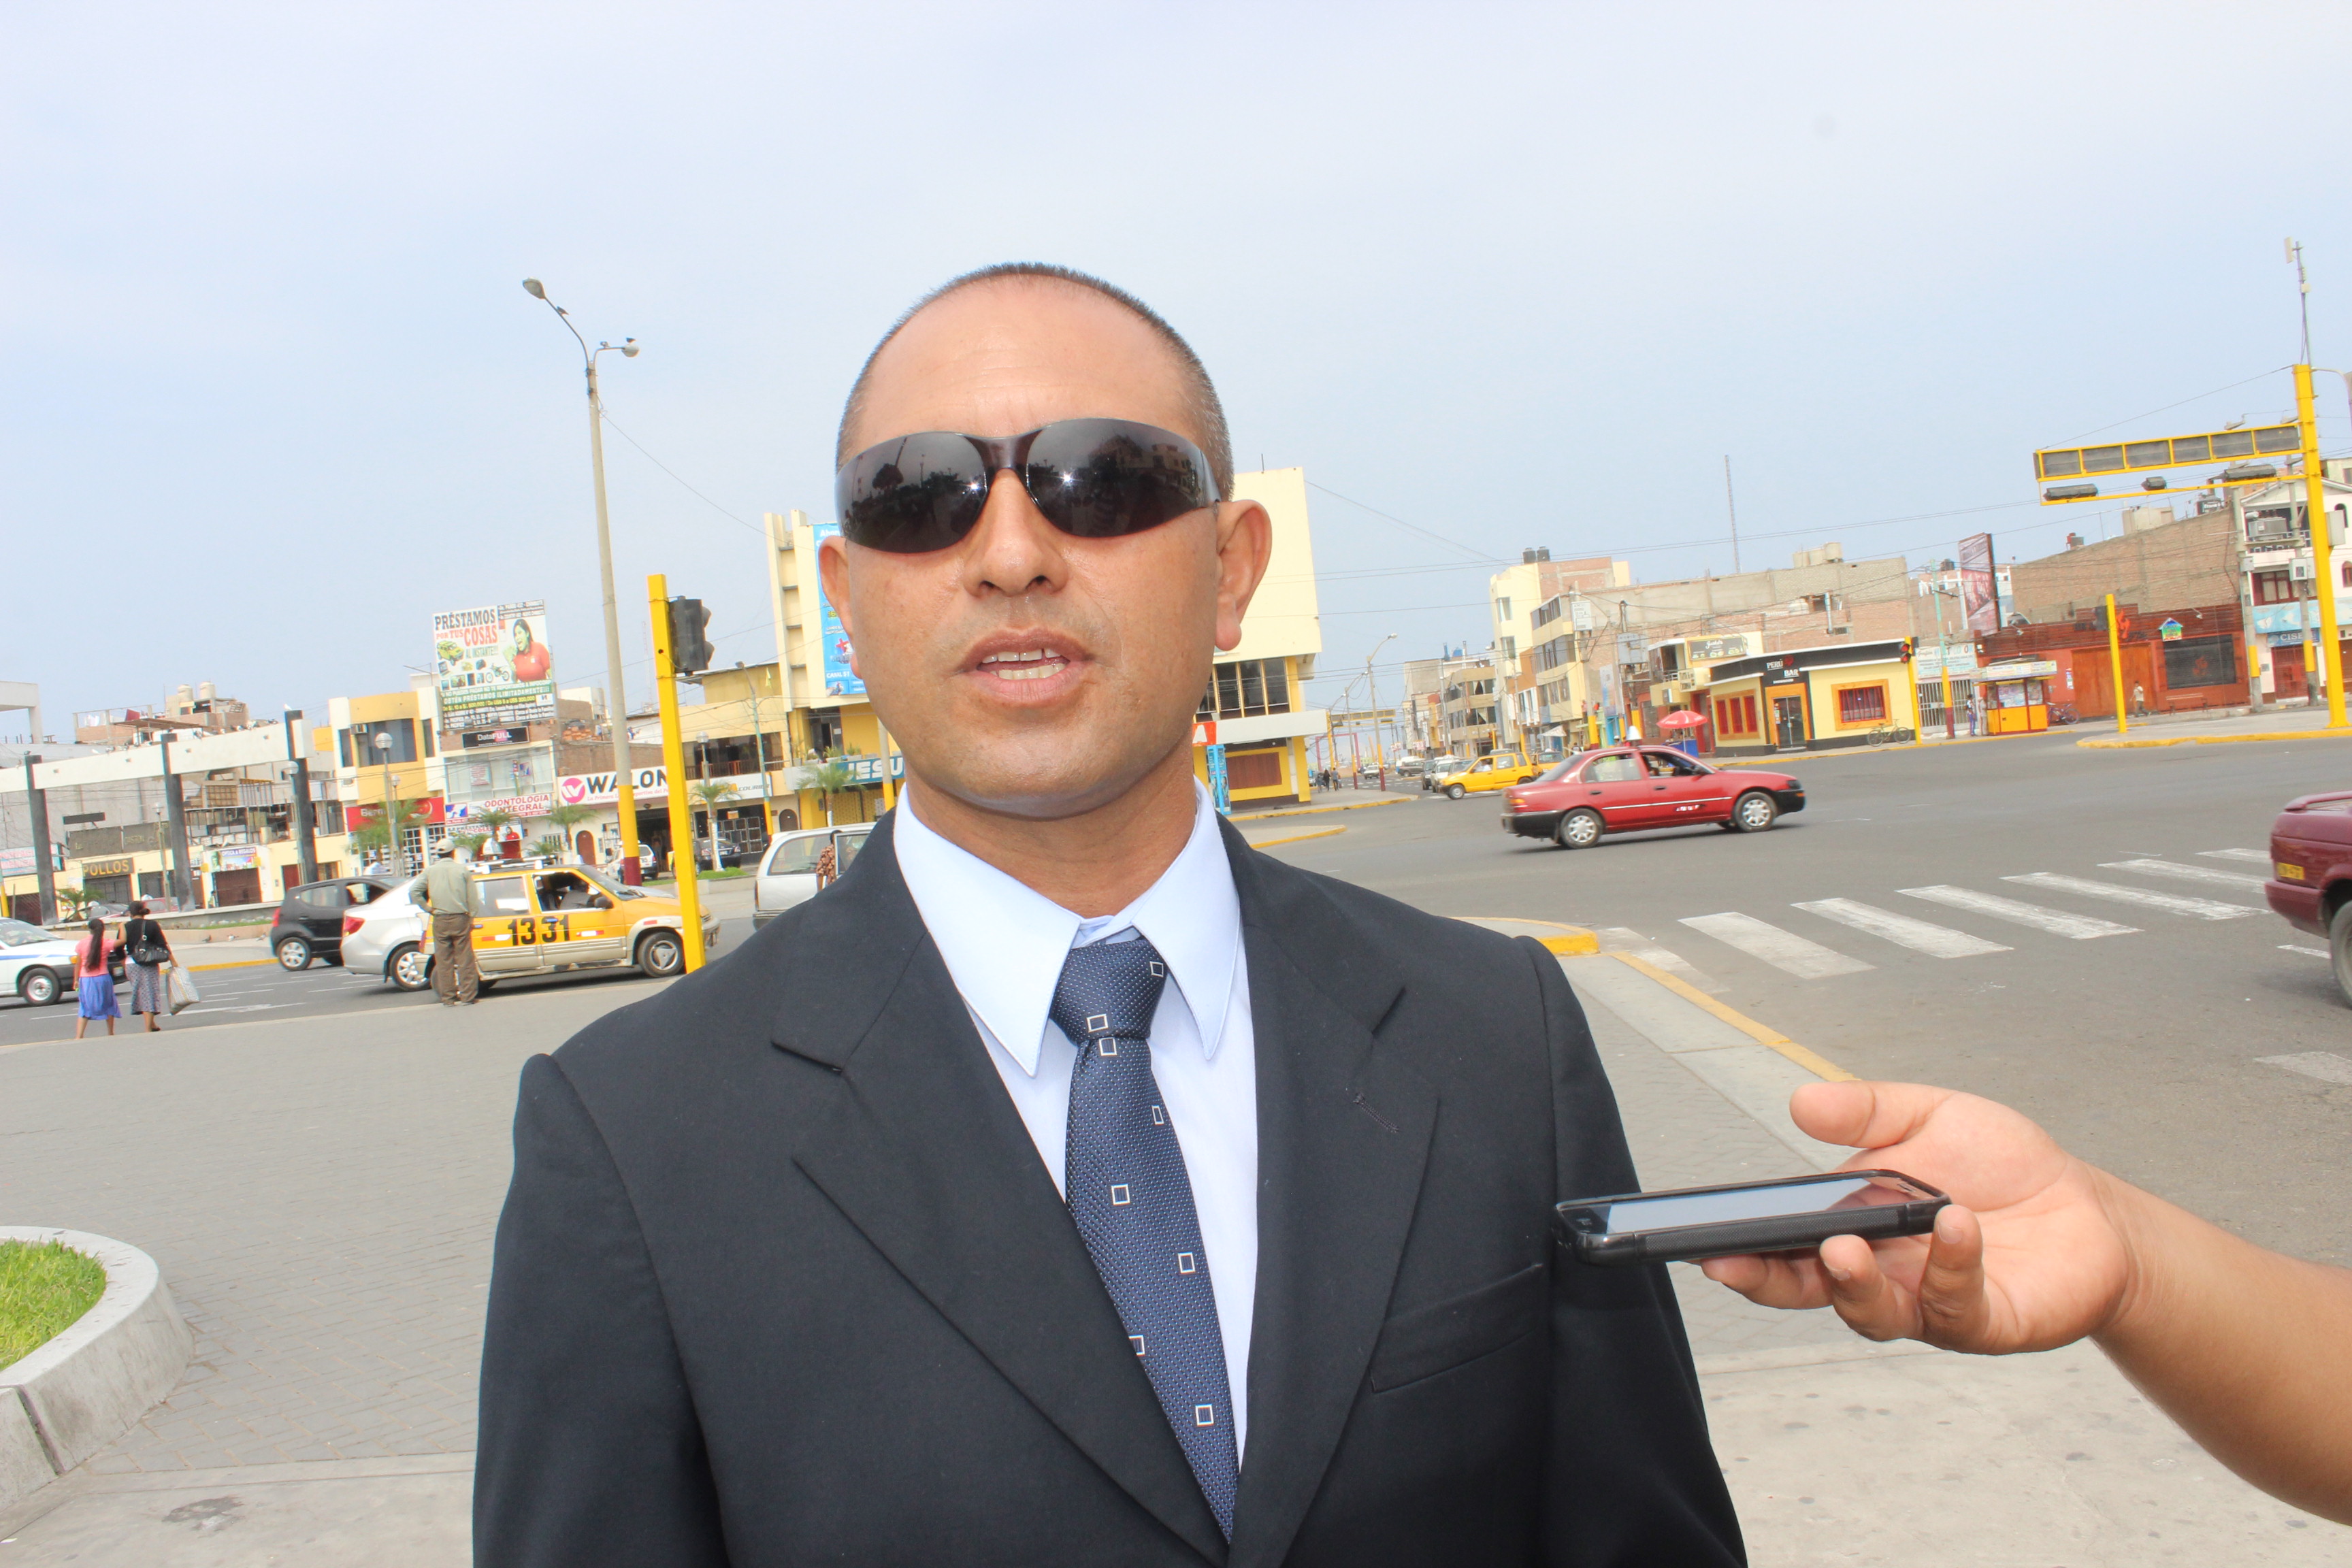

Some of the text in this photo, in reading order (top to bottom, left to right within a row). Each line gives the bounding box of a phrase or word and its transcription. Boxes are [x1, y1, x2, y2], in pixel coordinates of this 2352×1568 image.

[819, 529, 840, 538] Ahor
[434, 608, 496, 631] PRÉSTAMOS
[436, 625, 498, 647] POR TUS COSAS
[2280, 633, 2304, 641] CISE
[1767, 659, 1783, 669] PERÚ
[478, 732, 512, 741] DataFULL
[485, 794, 549, 808] ODONTOLOGIA
[83, 859, 129, 877] POLLOS
[508, 915, 570, 946] 1331
